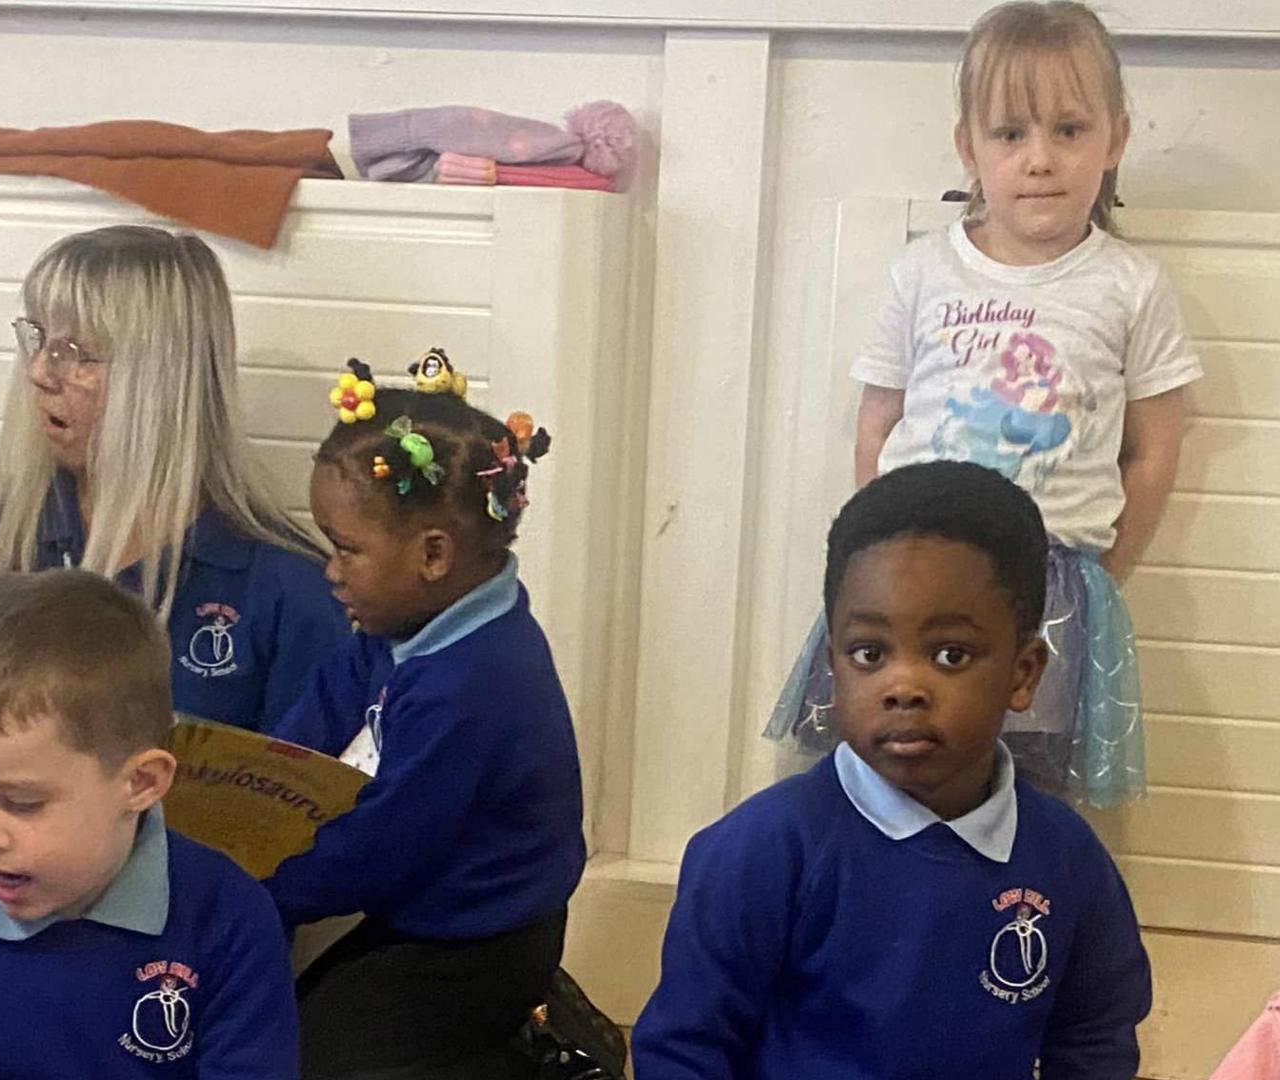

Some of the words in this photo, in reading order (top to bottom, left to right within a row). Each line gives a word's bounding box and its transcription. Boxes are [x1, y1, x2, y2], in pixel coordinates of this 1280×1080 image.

[937, 299, 1036, 328] Birthday
[951, 328, 1001, 367] Girl
[117, 1032, 163, 1063] Nursery
